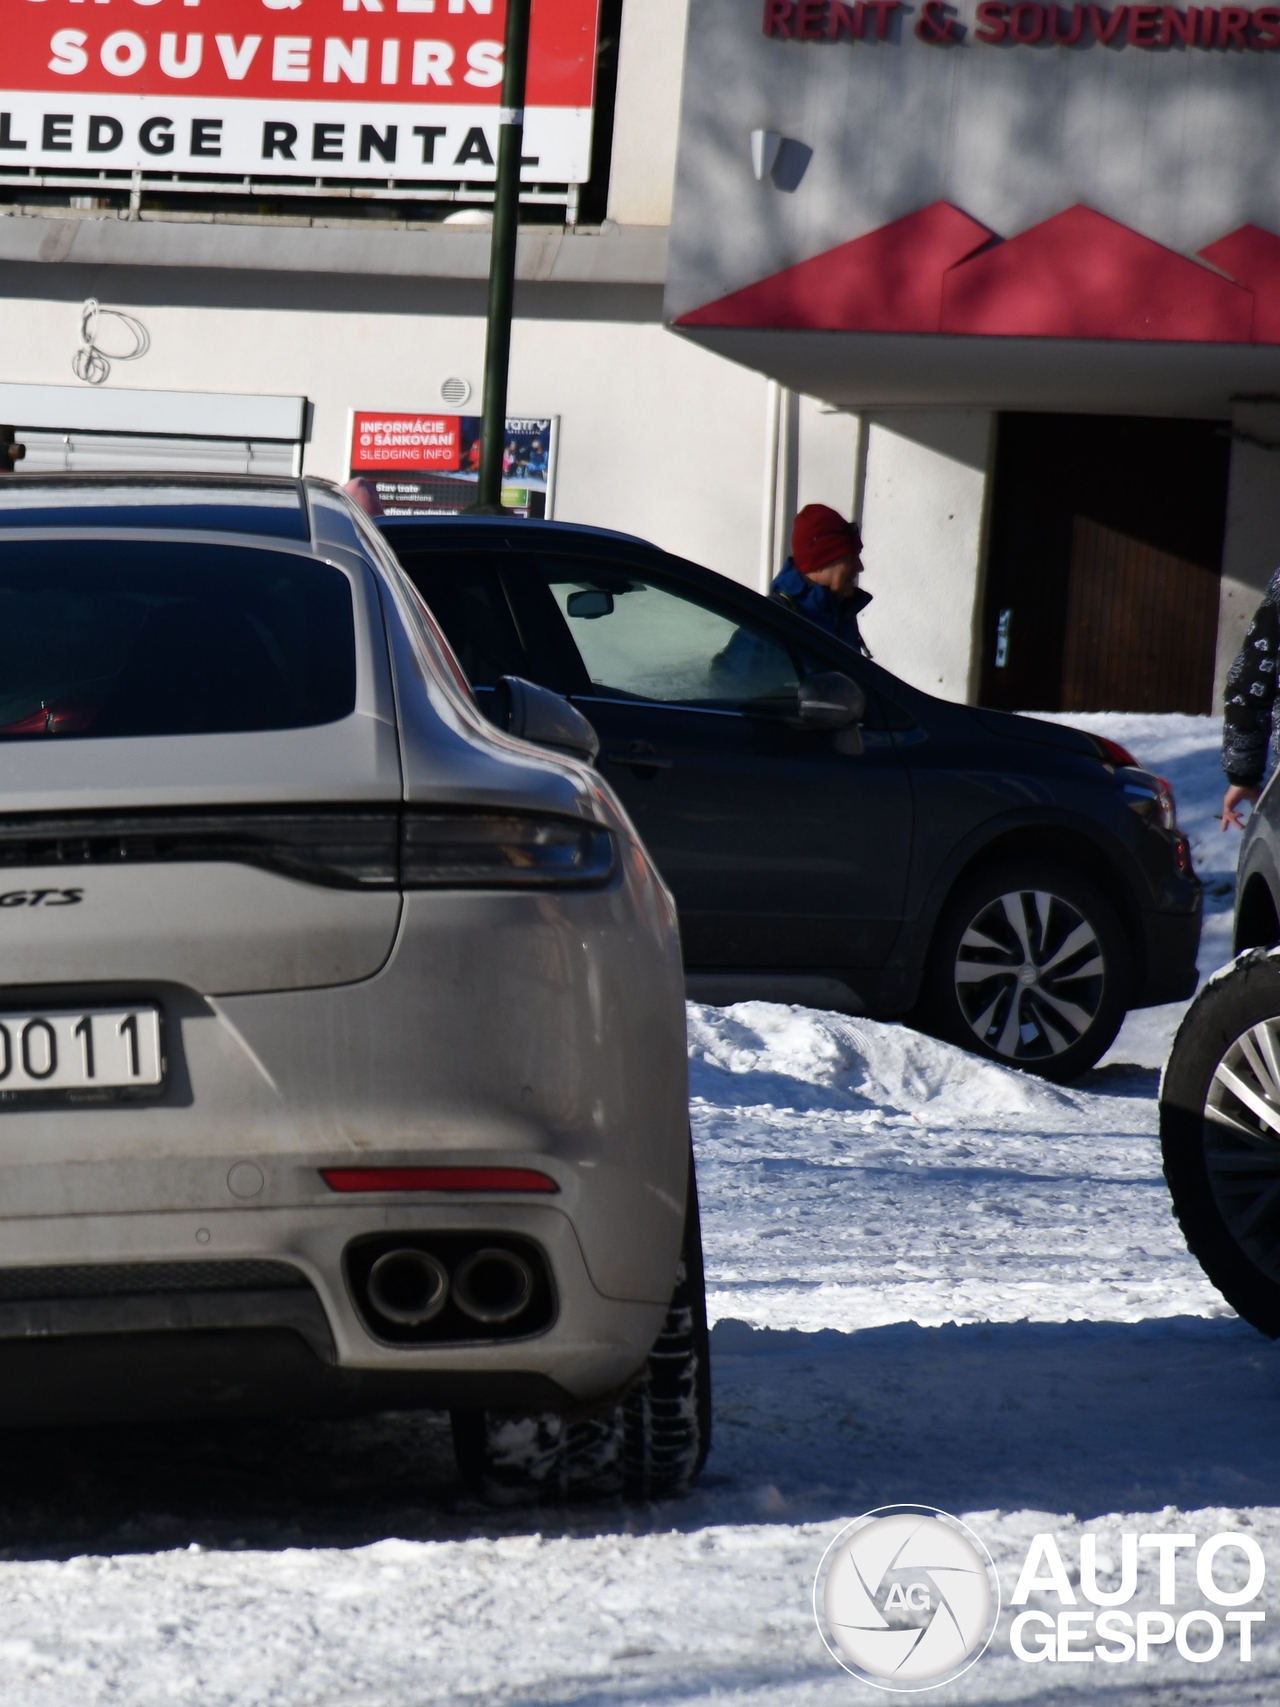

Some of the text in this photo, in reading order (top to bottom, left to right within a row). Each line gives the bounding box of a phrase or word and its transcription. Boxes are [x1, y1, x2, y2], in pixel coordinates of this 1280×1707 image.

[762, 0, 1280, 49] RENT & SOUVENIRS
[48, 29, 506, 88] SOUVENIRS
[360, 418, 445, 433] INFORMÁCIE
[360, 431, 454, 446] O SÁNKOVANÍ
[360, 449, 452, 460] SLEDGING INFO
